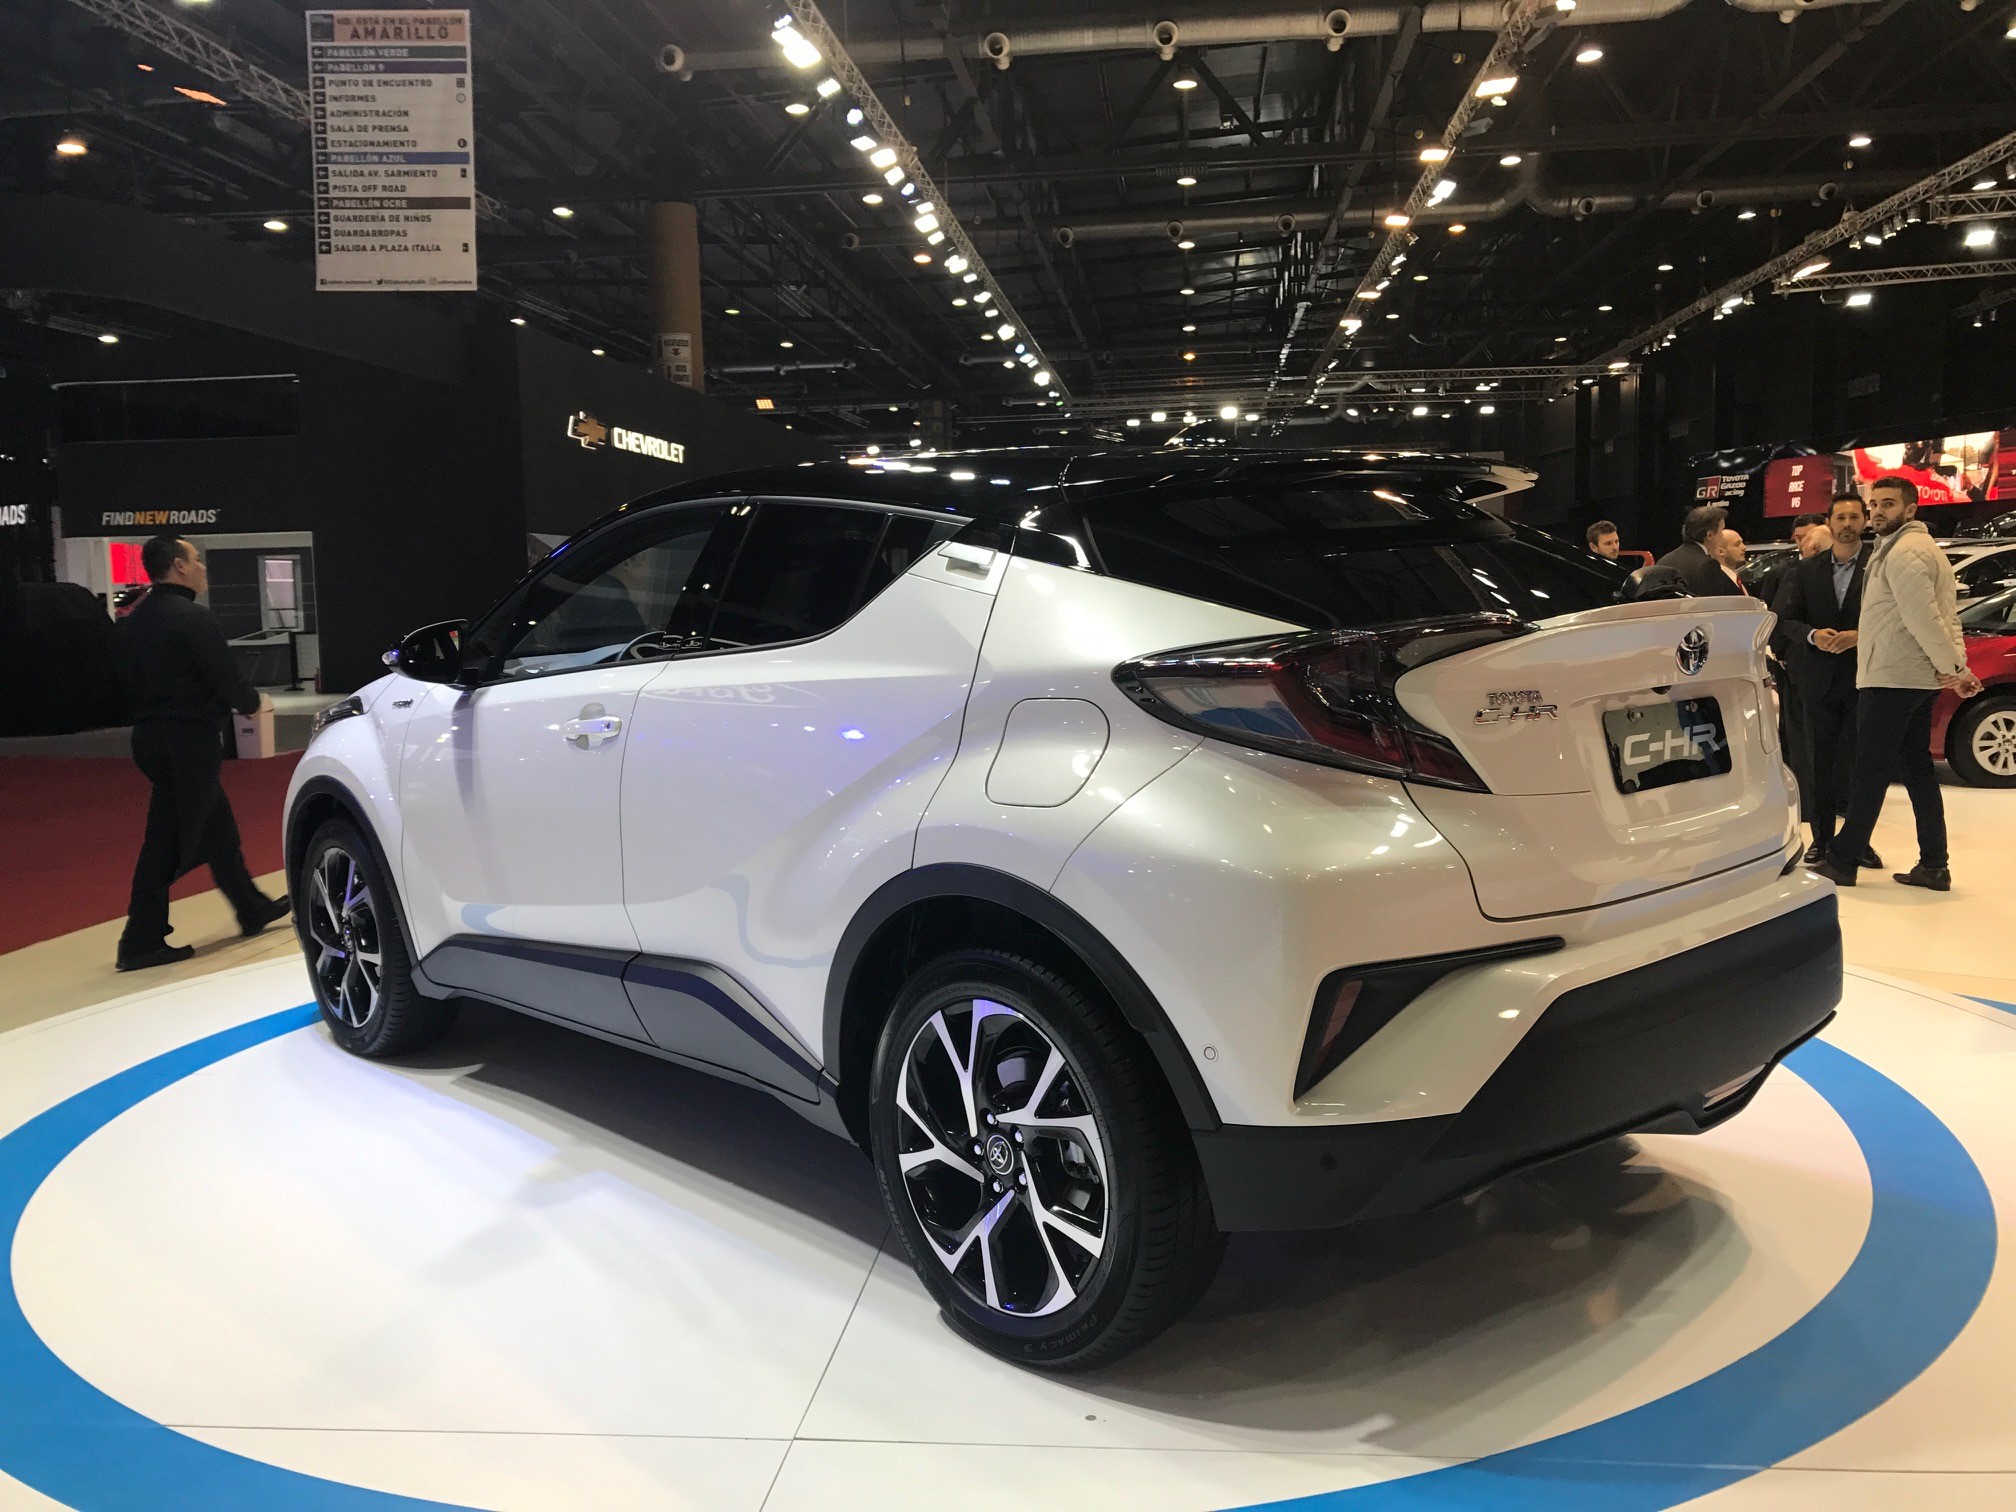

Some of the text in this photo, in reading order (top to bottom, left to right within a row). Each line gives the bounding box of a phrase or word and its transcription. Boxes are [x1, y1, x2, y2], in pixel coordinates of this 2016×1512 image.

[350, 26, 449, 40] AMARILLO
[378, 48, 409, 57] VERDE
[328, 79, 432, 87] PUNTO DE ENCUENTRO
[329, 94, 376, 103] INFORMES
[330, 125, 409, 133] SALA DE PRENSA
[330, 139, 418, 148] ESTACIONAMIENTO
[382, 154, 406, 163] AZUL
[331, 170, 438, 178] SALIDA AV. SARMIENTO
[332, 184, 407, 193] PISTA OFF ROAD
[382, 199, 408, 208] OCRE
[388, 214, 400, 222] DE
[403, 213, 432, 222] NIÑOS
[333, 229, 408, 237] GUARDARROPAS
[334, 244, 441, 252] SALIDA A PLAZA ITALIA
[612, 426, 685, 464] CHEVROLET
[1791, 465, 1804, 477] TOP
[1696, 474, 1749, 499] GR TOYOTA
[1720, 482, 1746, 490] GAZOO
[1788, 481, 1805, 493] RACE
[1791, 497, 1801, 508] V6
[0, 504, 26, 525] ADS
[1486, 689, 1544, 706] TOYOTA
[1474, 704, 1559, 725] C-HR
[1623, 722, 1720, 766] C-HR
